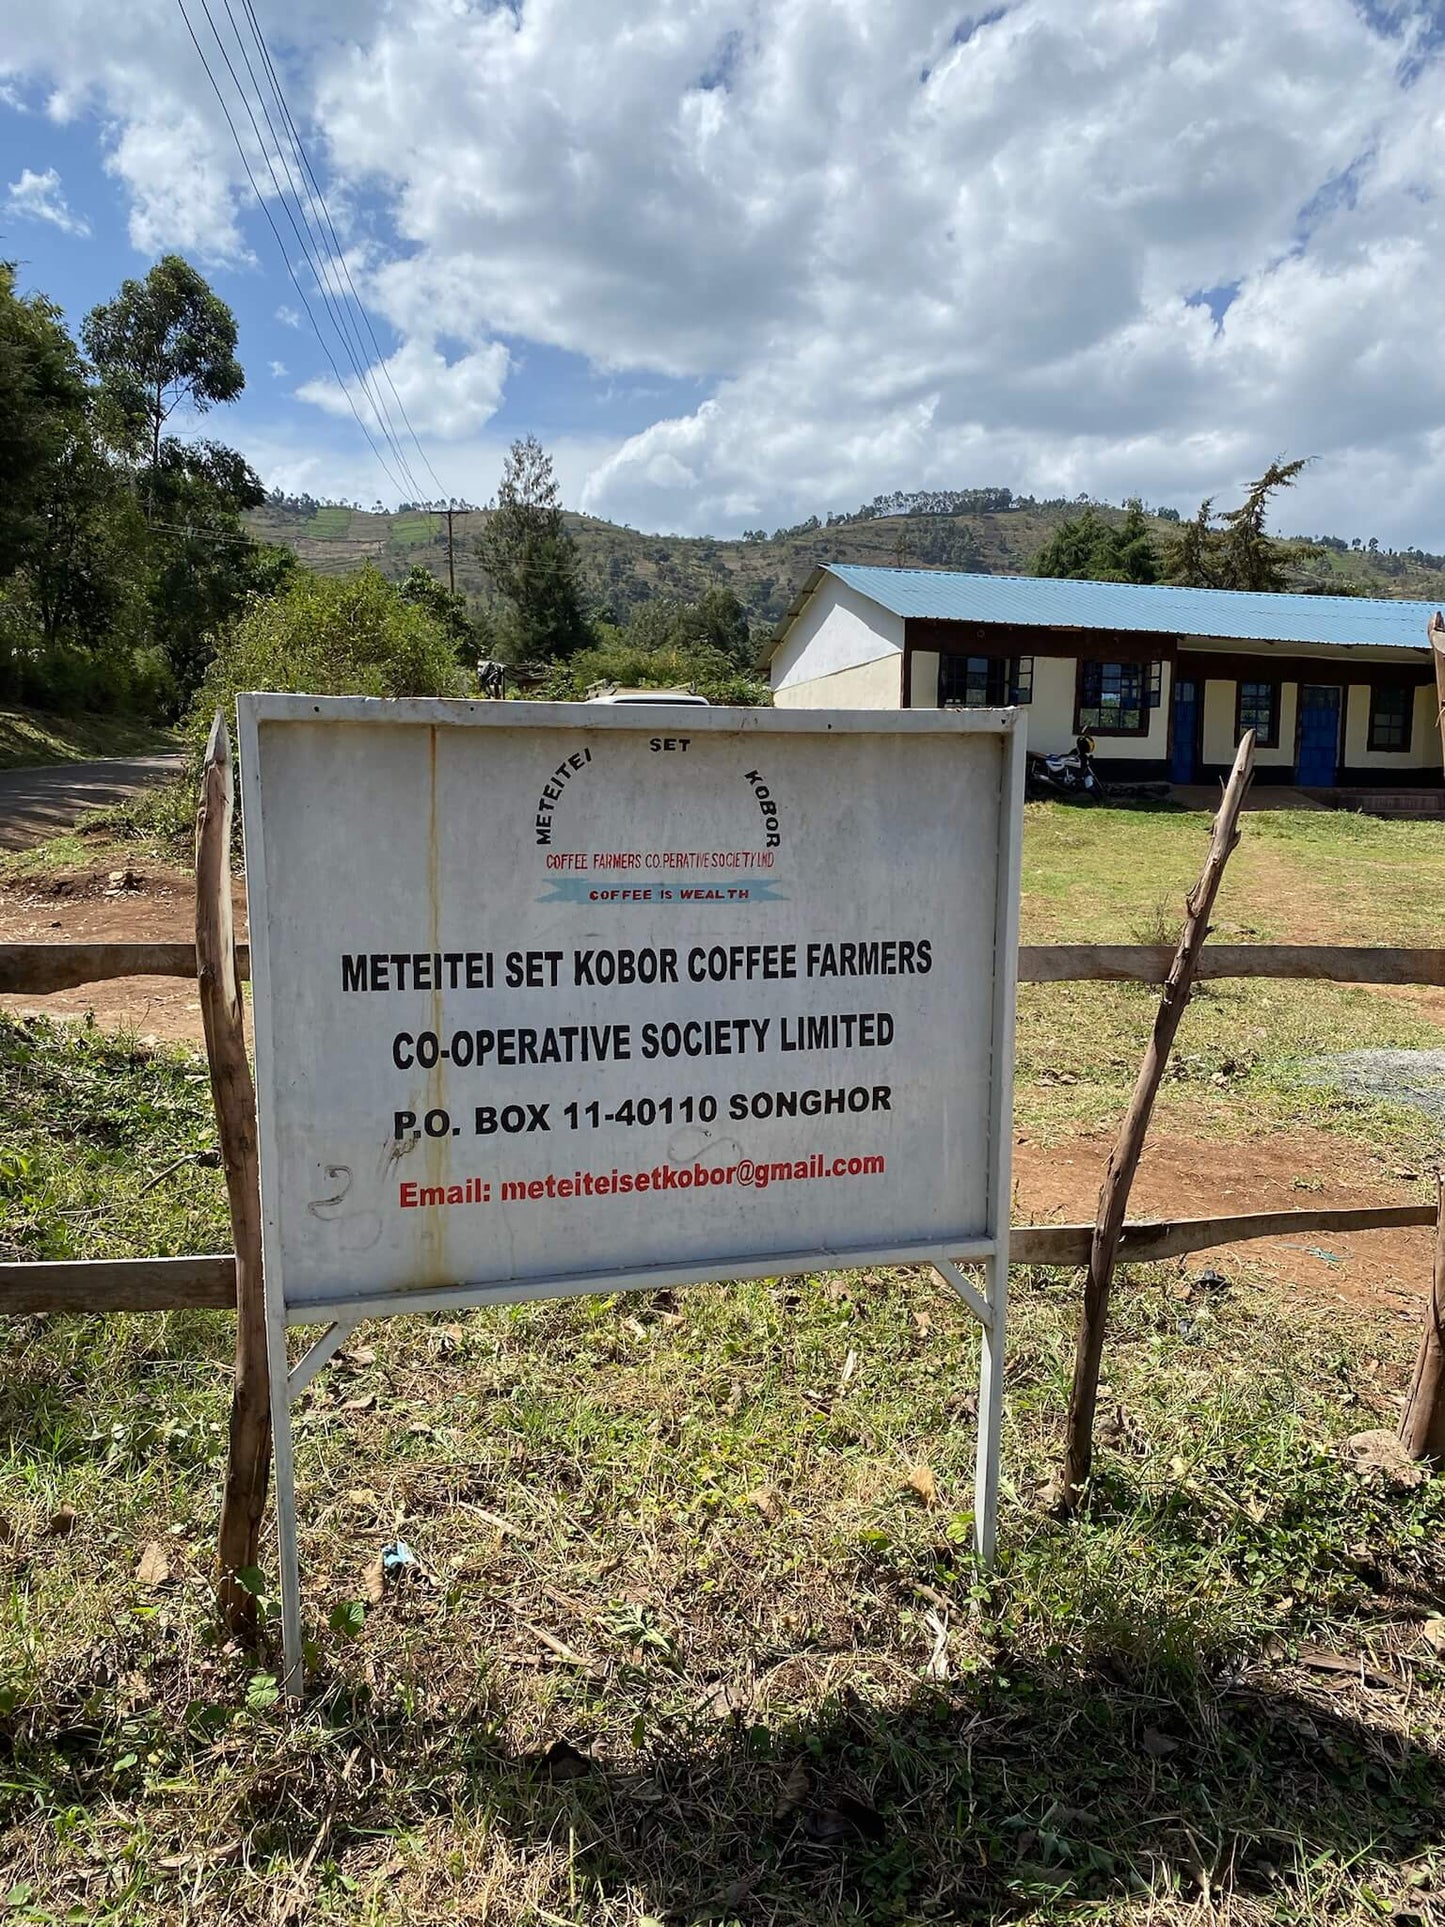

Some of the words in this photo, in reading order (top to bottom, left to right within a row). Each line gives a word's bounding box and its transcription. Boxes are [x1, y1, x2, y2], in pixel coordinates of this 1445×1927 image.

[650, 738, 691, 752] SET
[536, 748, 592, 845] METEITEI
[745, 770, 780, 848] KOBOR
[546, 853, 588, 870] COFFEE
[589, 890, 652, 900] COFFEE
[660, 890, 673, 899] IS
[680, 889, 749, 900] WEALTH
[342, 953, 493, 991] METEITEI
[505, 950, 563, 988] SET
[573, 947, 679, 986] KOBOR
[688, 943, 797, 981] COFFEE
[806, 939, 932, 977] FARMERS
[392, 1024, 631, 1070] CO-OPERATIVE
[640, 1018, 771, 1060] SOCIETY
[780, 1012, 894, 1051] LIMITED
[394, 1110, 460, 1140] P.O.
[475, 1104, 551, 1134] BOX
[563, 1095, 718, 1130] 11-40110
[729, 1085, 892, 1120] SONGHOR
[400, 1178, 492, 1208] Email:
[501, 1153, 884, 1201] meteiteisetkobor@gmail.com
